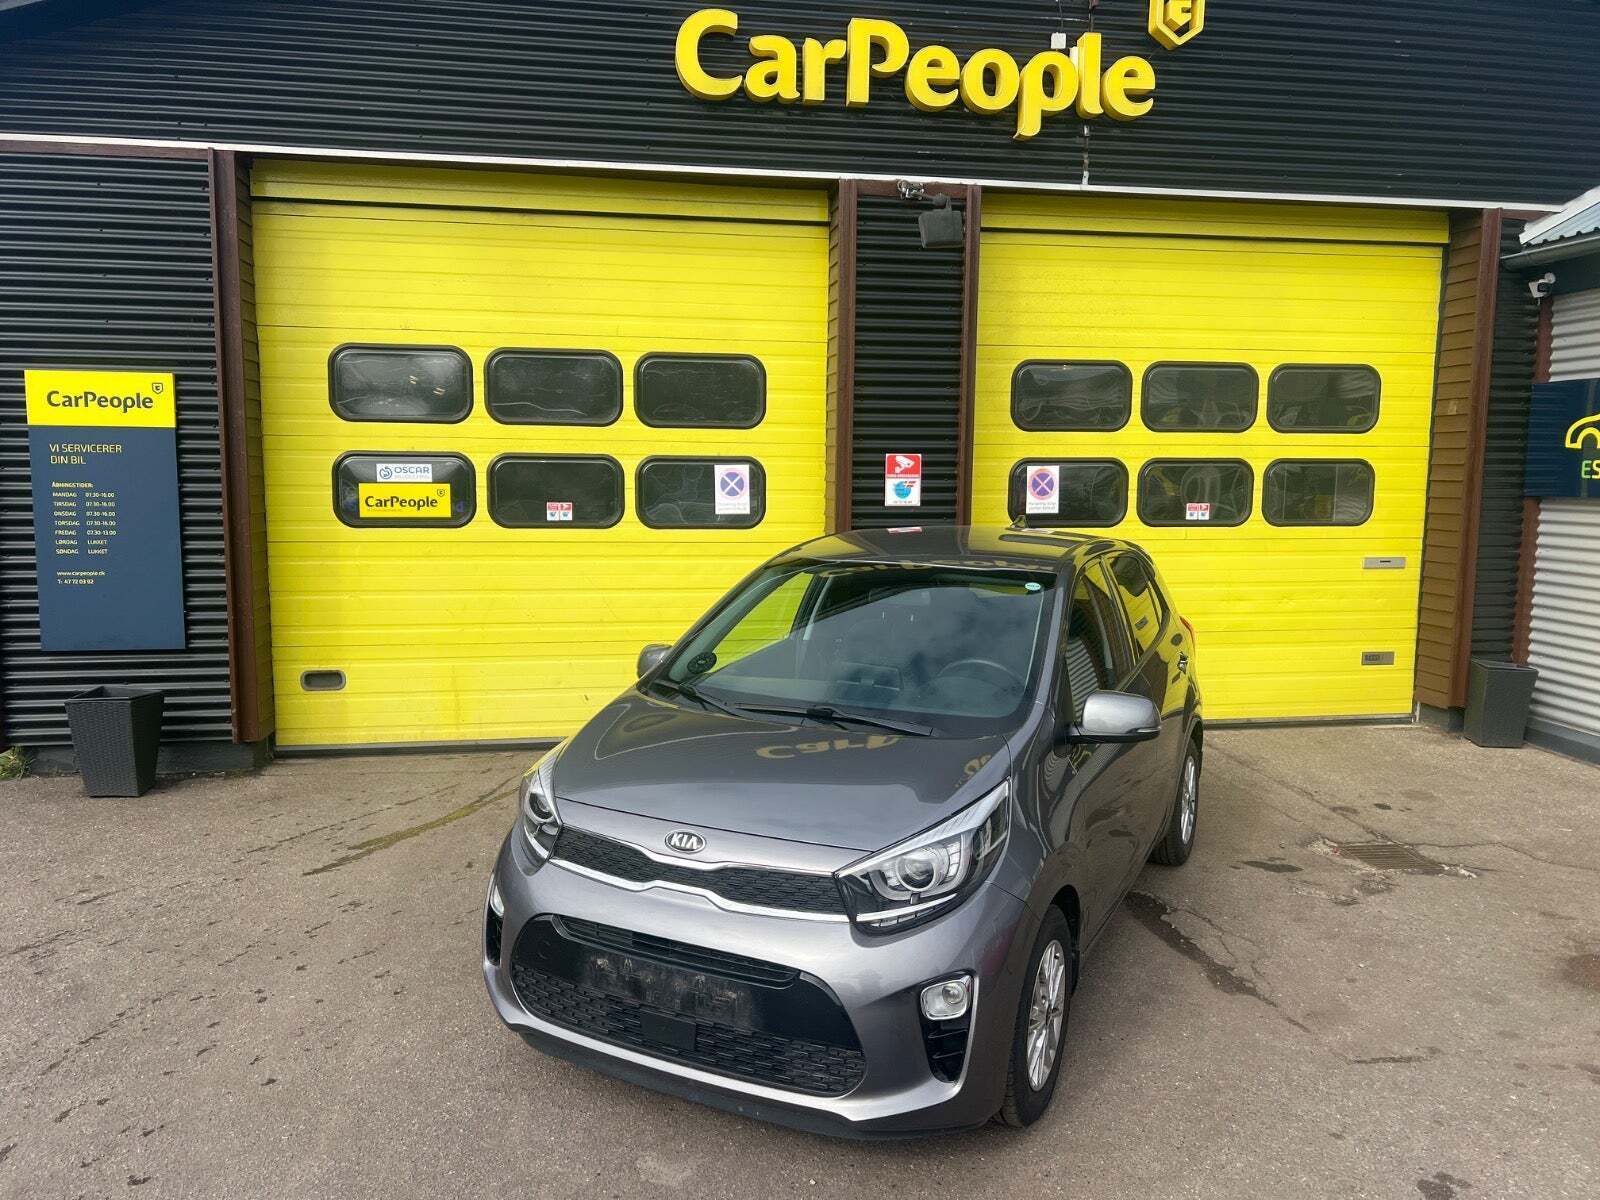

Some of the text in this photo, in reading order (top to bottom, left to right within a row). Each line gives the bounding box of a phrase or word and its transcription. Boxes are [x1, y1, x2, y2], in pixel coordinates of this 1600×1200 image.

[675, 8, 1156, 140] CarPeople
[47, 390, 153, 413] CarPeople
[49, 444, 122, 453] VI SERVICERER
[50, 455, 86, 464] DIN BIL
[394, 466, 430, 474] OSCAR
[365, 496, 438, 511] CarPeople
[671, 832, 698, 850] KIA
